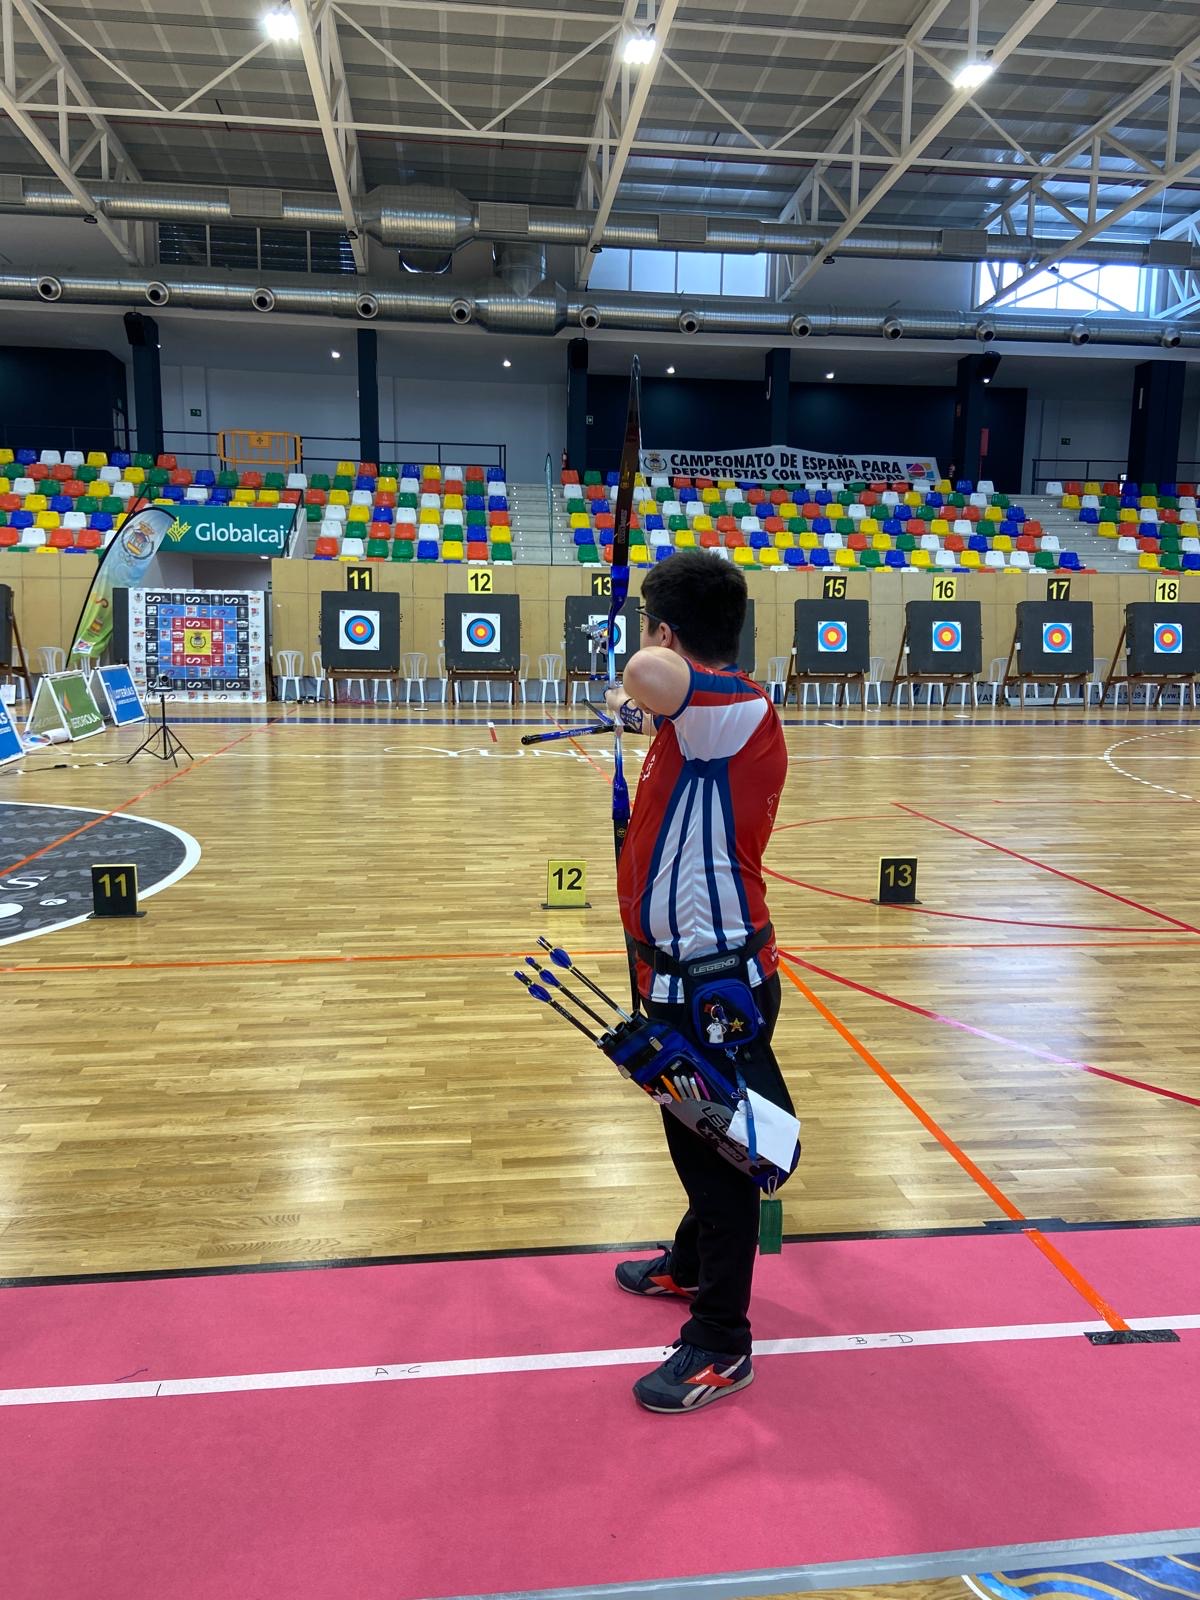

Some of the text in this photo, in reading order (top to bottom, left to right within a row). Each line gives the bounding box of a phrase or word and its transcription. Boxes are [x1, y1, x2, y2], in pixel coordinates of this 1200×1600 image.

[670, 452, 902, 474] CAMPEONATO DE ESPAÑA PARA
[672, 467, 906, 482] DEPORTISTAS CON DISCAPACIDAD
[195, 522, 288, 549] Globalcaj
[349, 570, 372, 590] 11
[469, 572, 492, 592] 12
[593, 576, 612, 596] 13
[824, 578, 845, 597] 15
[934, 580, 955, 599] 16
[1048, 581, 1070, 600] 17
[1157, 582, 1178, 601] 18
[98, 872, 128, 898] 11
[552, 867, 583, 891] 12
[884, 864, 913, 887] 13
[693, 957, 736, 975] LEGEND
